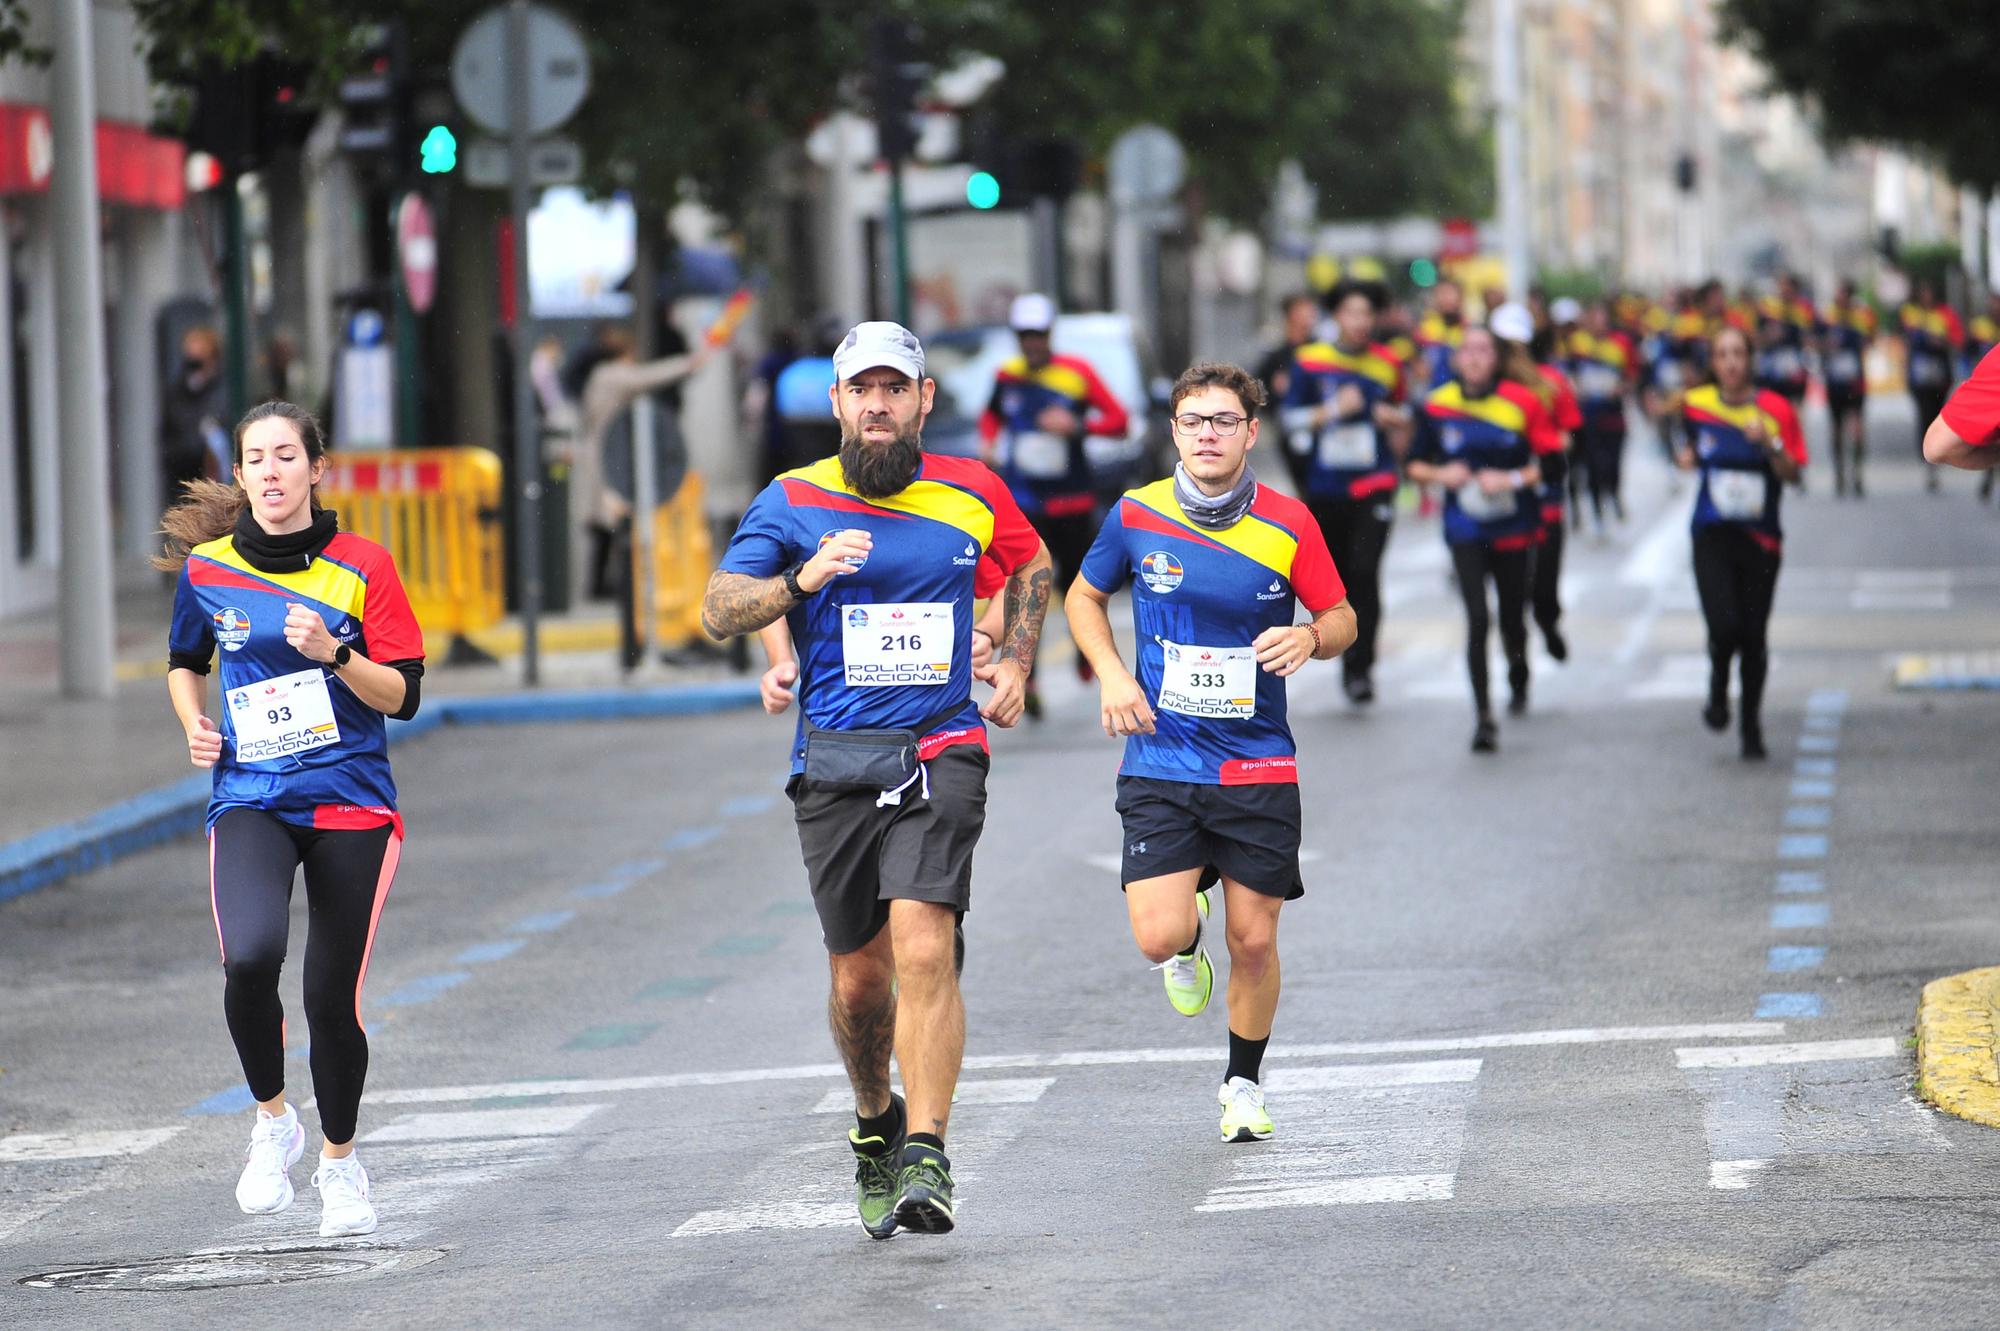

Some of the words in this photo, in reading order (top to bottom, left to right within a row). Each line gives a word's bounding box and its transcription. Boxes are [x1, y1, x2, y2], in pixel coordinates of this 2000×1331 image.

[881, 635, 922, 651] 216
[848, 664, 933, 673] POLICIA
[849, 673, 947, 682] NACIONAL
[1190, 674, 1225, 688] 333
[1162, 698, 1252, 714] NACIONAL
[1164, 690, 1233, 706] POLICIA
[267, 706, 293, 725] 93
[240, 728, 314, 752] POLICIA
[240, 733, 338, 759] NACIONAL
